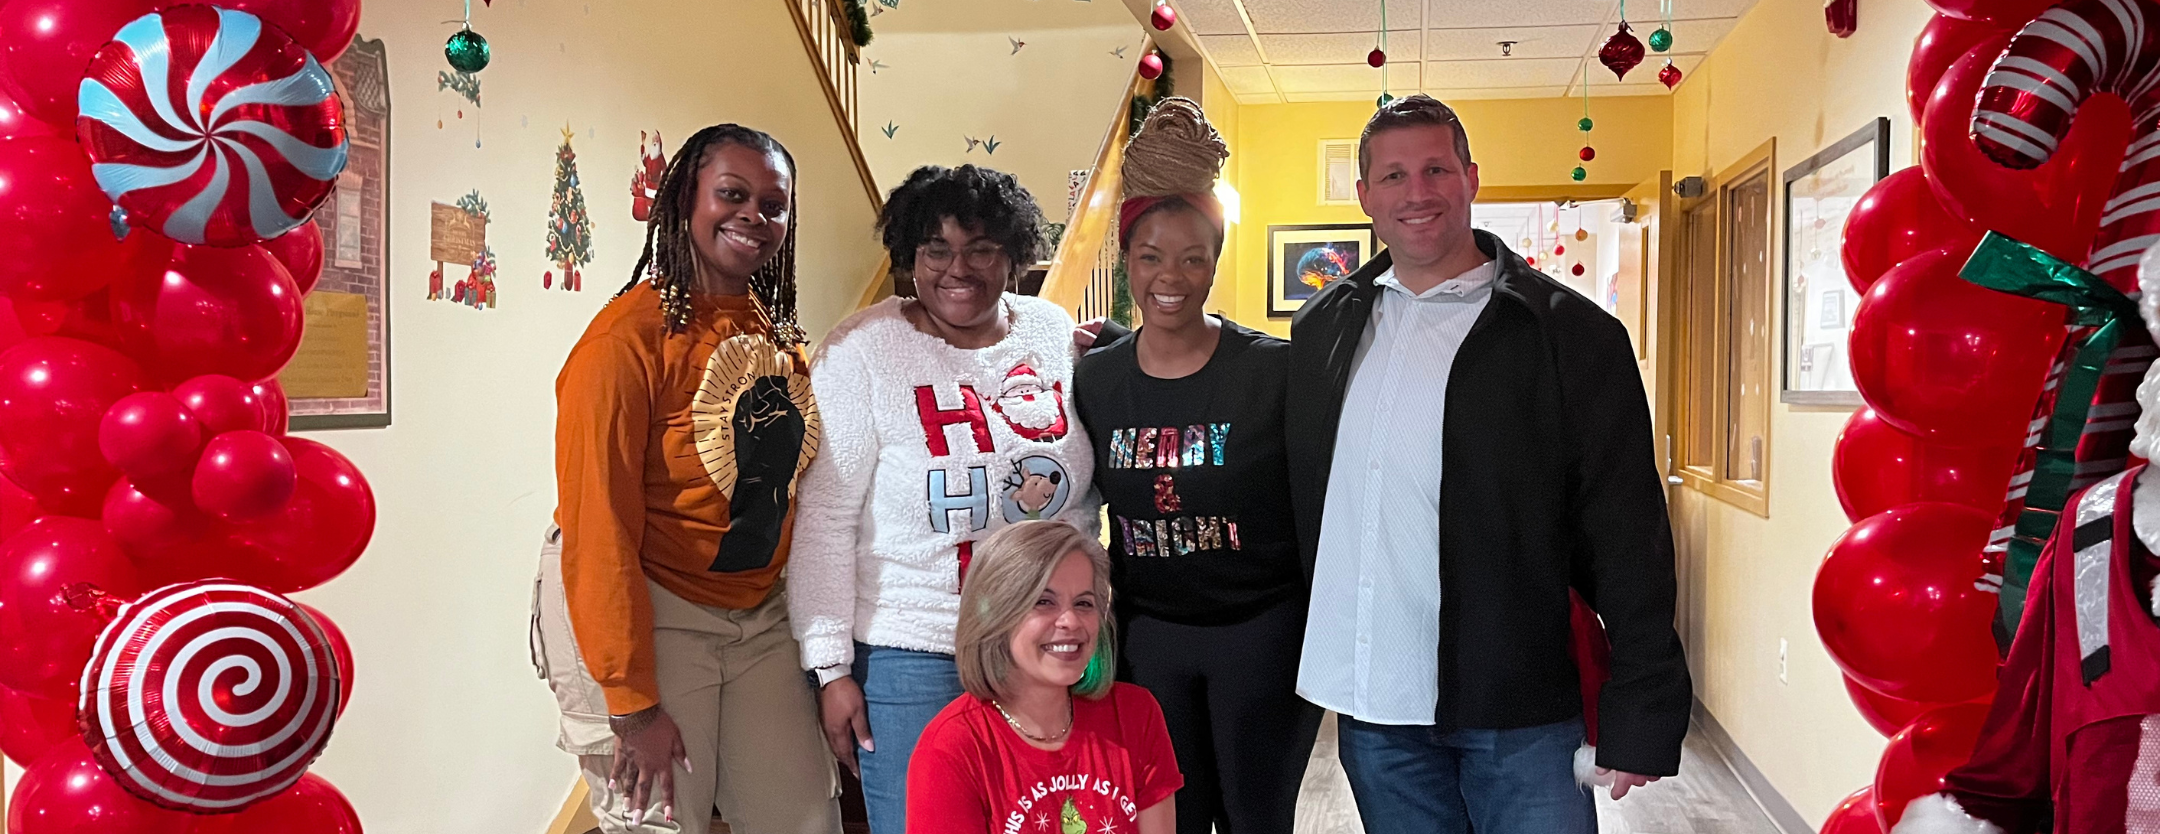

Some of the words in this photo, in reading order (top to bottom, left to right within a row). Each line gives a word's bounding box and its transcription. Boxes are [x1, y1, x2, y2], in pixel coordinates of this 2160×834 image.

[722, 371, 756, 405] STRON
[719, 405, 731, 441] STAY
[1108, 422, 1231, 469] MERRY
[928, 455, 1070, 533] HO
[1153, 473, 1182, 514] &
[1003, 810, 1026, 834] HIS
[1017, 795, 1033, 814] IS
[1030, 781, 1048, 802] AS
[1049, 773, 1089, 793] JOLLY
[1092, 777, 1111, 796] AS
[1111, 786, 1119, 800] I
